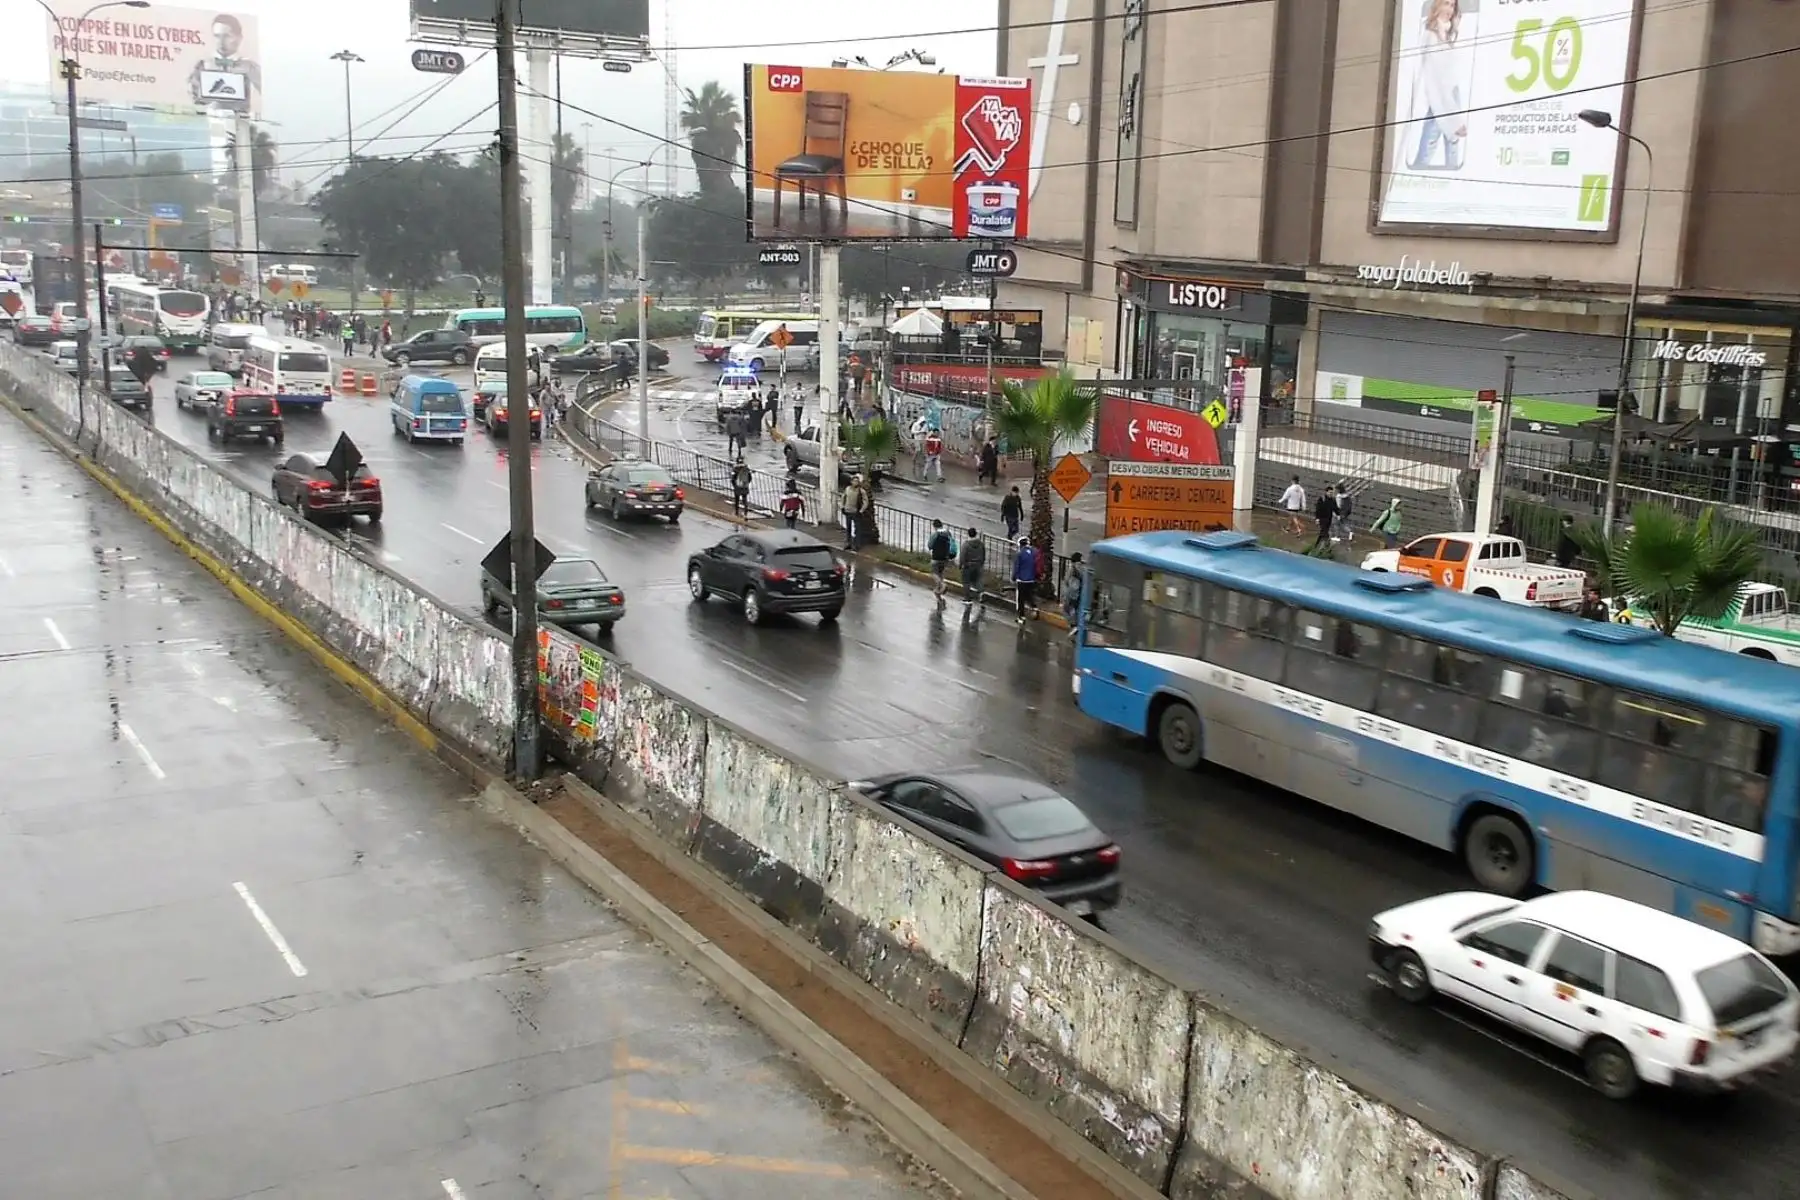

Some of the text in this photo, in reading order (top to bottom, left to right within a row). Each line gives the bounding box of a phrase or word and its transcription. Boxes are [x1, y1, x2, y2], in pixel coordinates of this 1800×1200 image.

[114, 21, 130, 37] EN
[133, 23, 155, 40] LOS
[97, 39, 118, 55] SIN
[1505, 16, 1582, 93] 50
[417, 52, 445, 66] JMT
[84, 68, 156, 84] PagoEfectivo
[770, 73, 800, 89] CPP
[1495, 112, 1579, 123] PRODUCTOS DE LAS
[1494, 124, 1577, 134] MEJORES MARCAS
[850, 141, 924, 156] ¿CHOQUE
[857, 155, 933, 170] DE SILLA?
[760, 252, 800, 263] ANT-003
[972, 254, 998, 268] JMT
[1356, 264, 1395, 284] saga
[1651, 340, 1686, 360] Mis
[1146, 419, 1182, 439] INGRESO
[1145, 437, 1189, 459] VEHICULAR
[1111, 464, 1231, 478] DESVIO OBRAS METRO DE LIMA
[1129, 484, 1227, 504] CARRETERA CENTRAL
[1132, 516, 1201, 532] EVITAMIENTO
